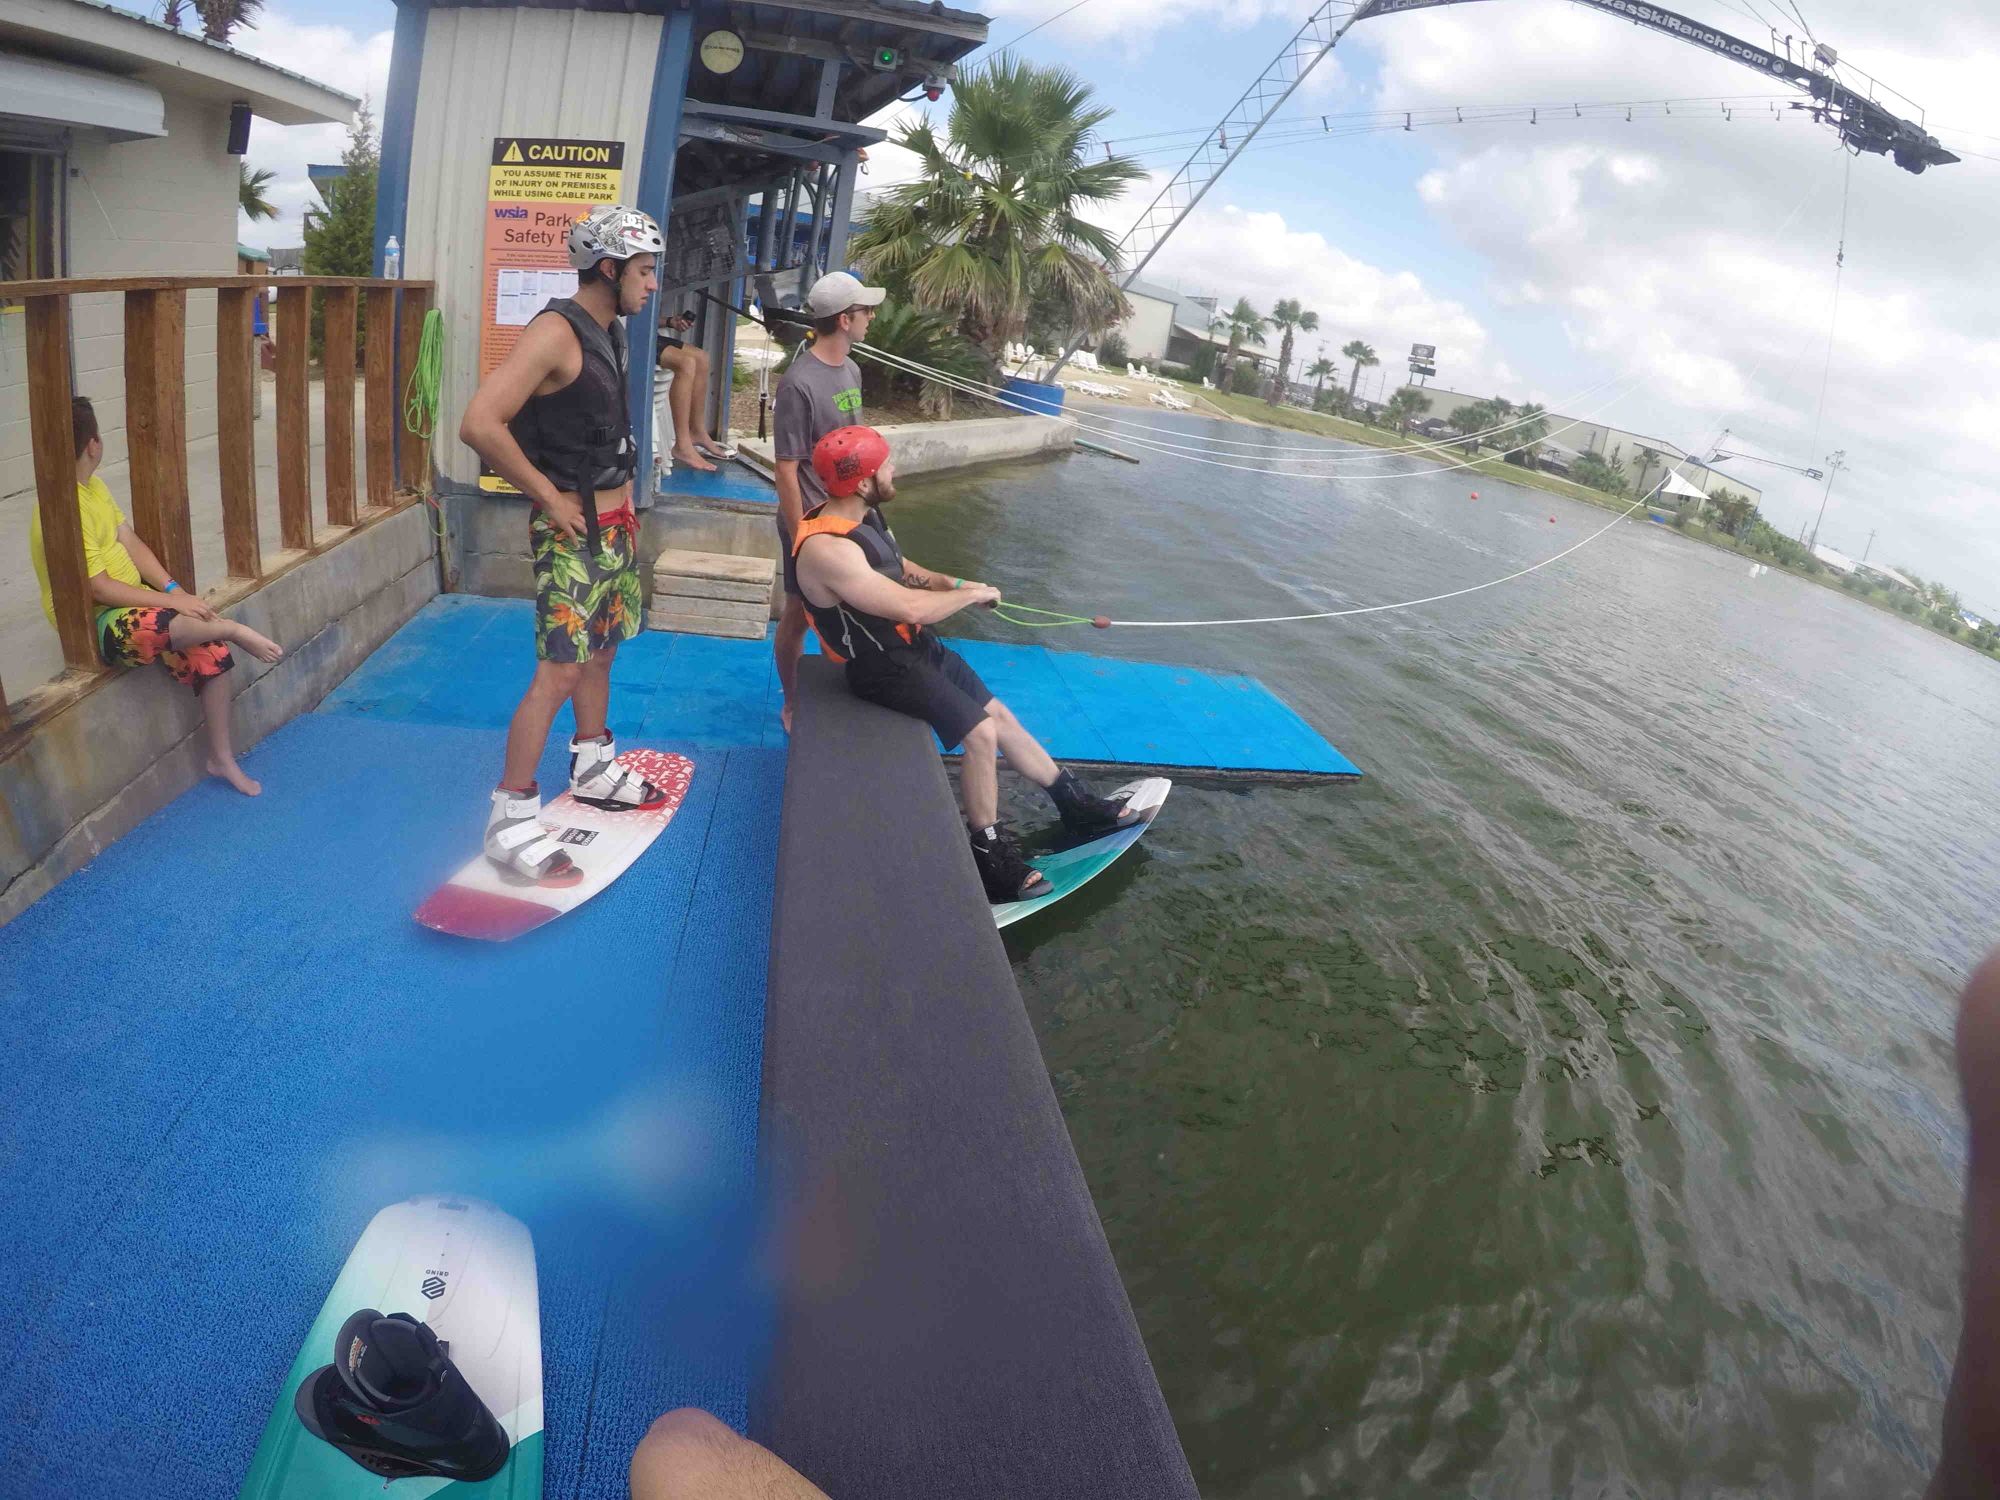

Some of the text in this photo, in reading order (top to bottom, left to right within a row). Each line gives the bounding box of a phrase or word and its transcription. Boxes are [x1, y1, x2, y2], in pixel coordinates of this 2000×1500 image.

[1594, 0, 1769, 65] xasSkiRanch.com
[528, 144, 610, 163] CAUTION
[503, 169, 607, 180] YOU ASSUME THE RISK
[495, 179, 507, 187] OF
[545, 180, 559, 188] ON
[561, 181, 607, 190] PREMISES
[493, 189, 613, 200] WHILE USING CABLE PARK
[494, 206, 528, 219] wsia
[535, 212, 572, 227] Park
[504, 228, 555, 247] Safety
[425, 1269, 449, 1277] GRIND
